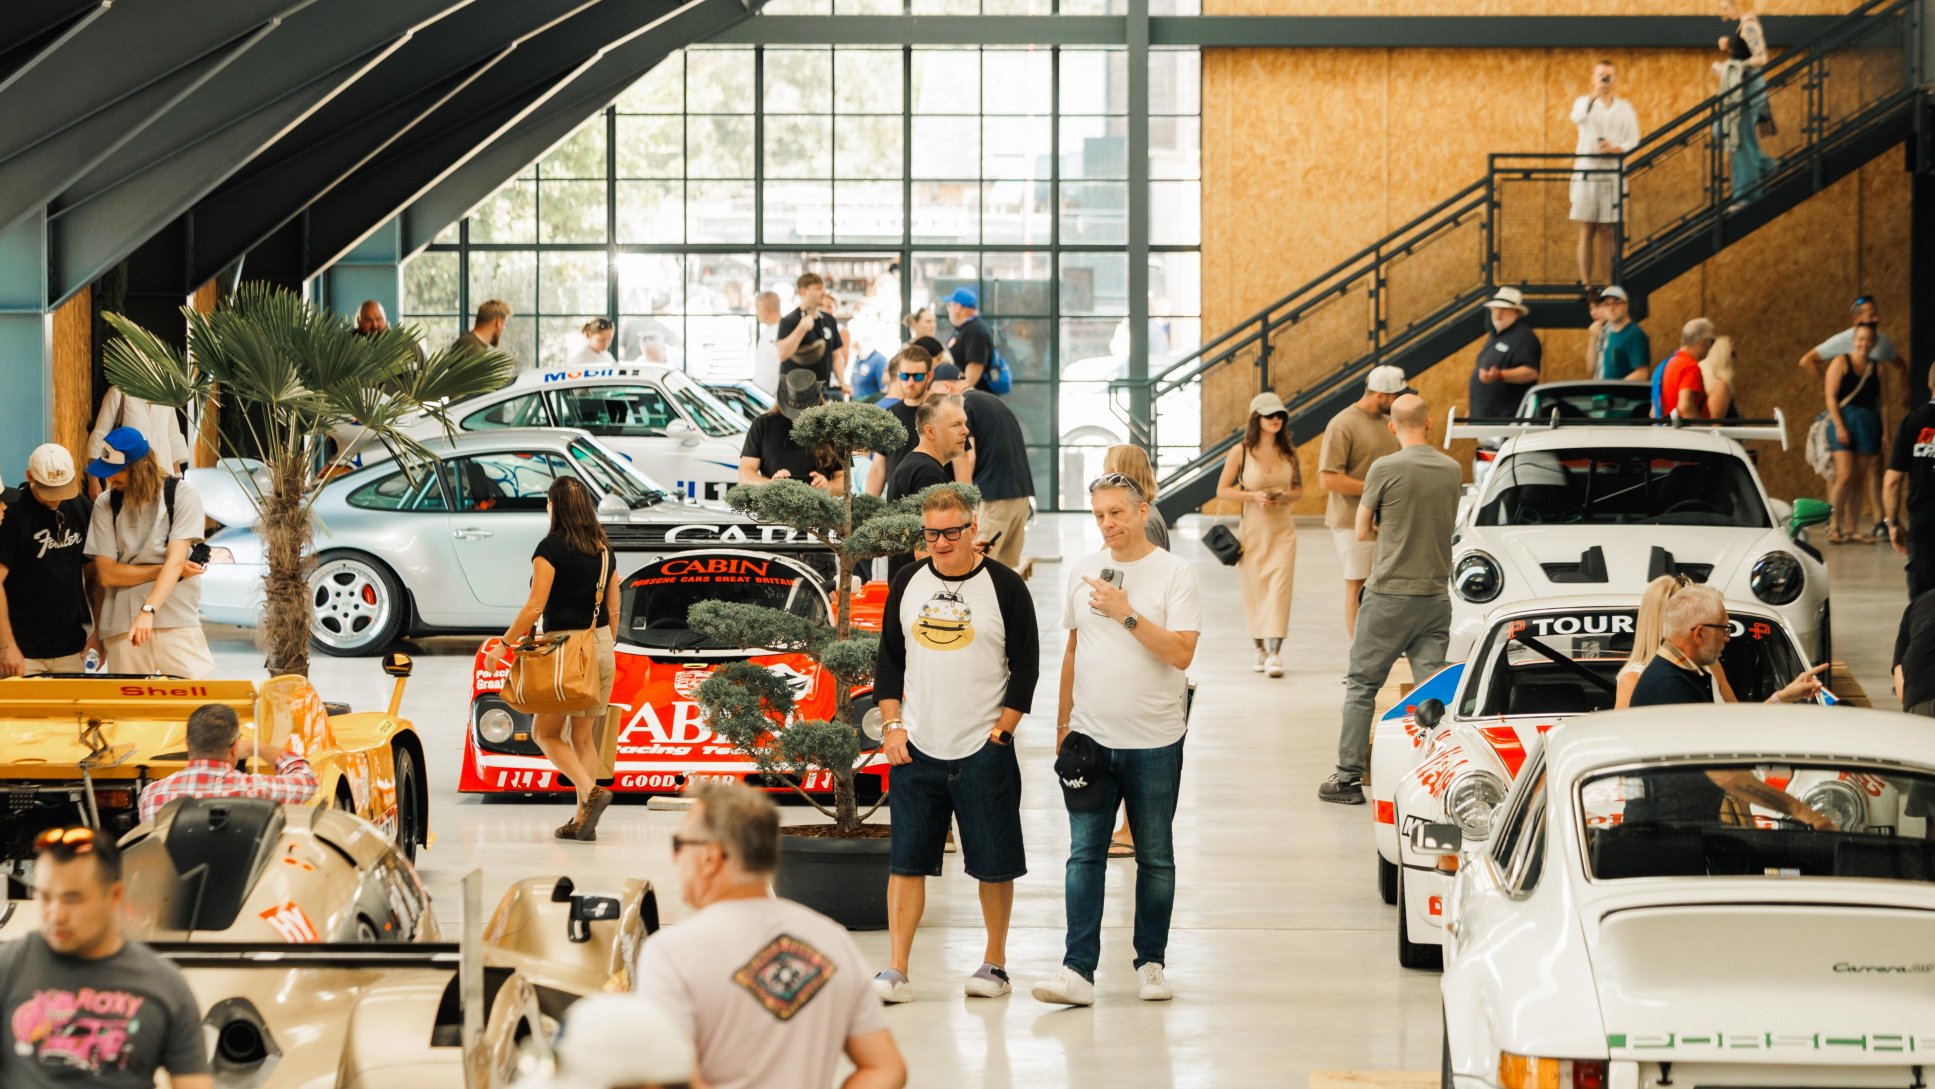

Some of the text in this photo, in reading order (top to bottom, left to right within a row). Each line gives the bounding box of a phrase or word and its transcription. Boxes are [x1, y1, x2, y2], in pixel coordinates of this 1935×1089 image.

[664, 524, 845, 544] CAB
[660, 559, 769, 576] CABIN
[630, 577, 677, 589] PORSCHE
[680, 576, 711, 584] CARS
[715, 575, 751, 584] GREAT
[1532, 615, 1635, 636] TOUR
[476, 669, 509, 680] Posc
[120, 686, 207, 696] Shell
[617, 744, 692, 756] acing
[621, 774, 675, 788] GOOD
